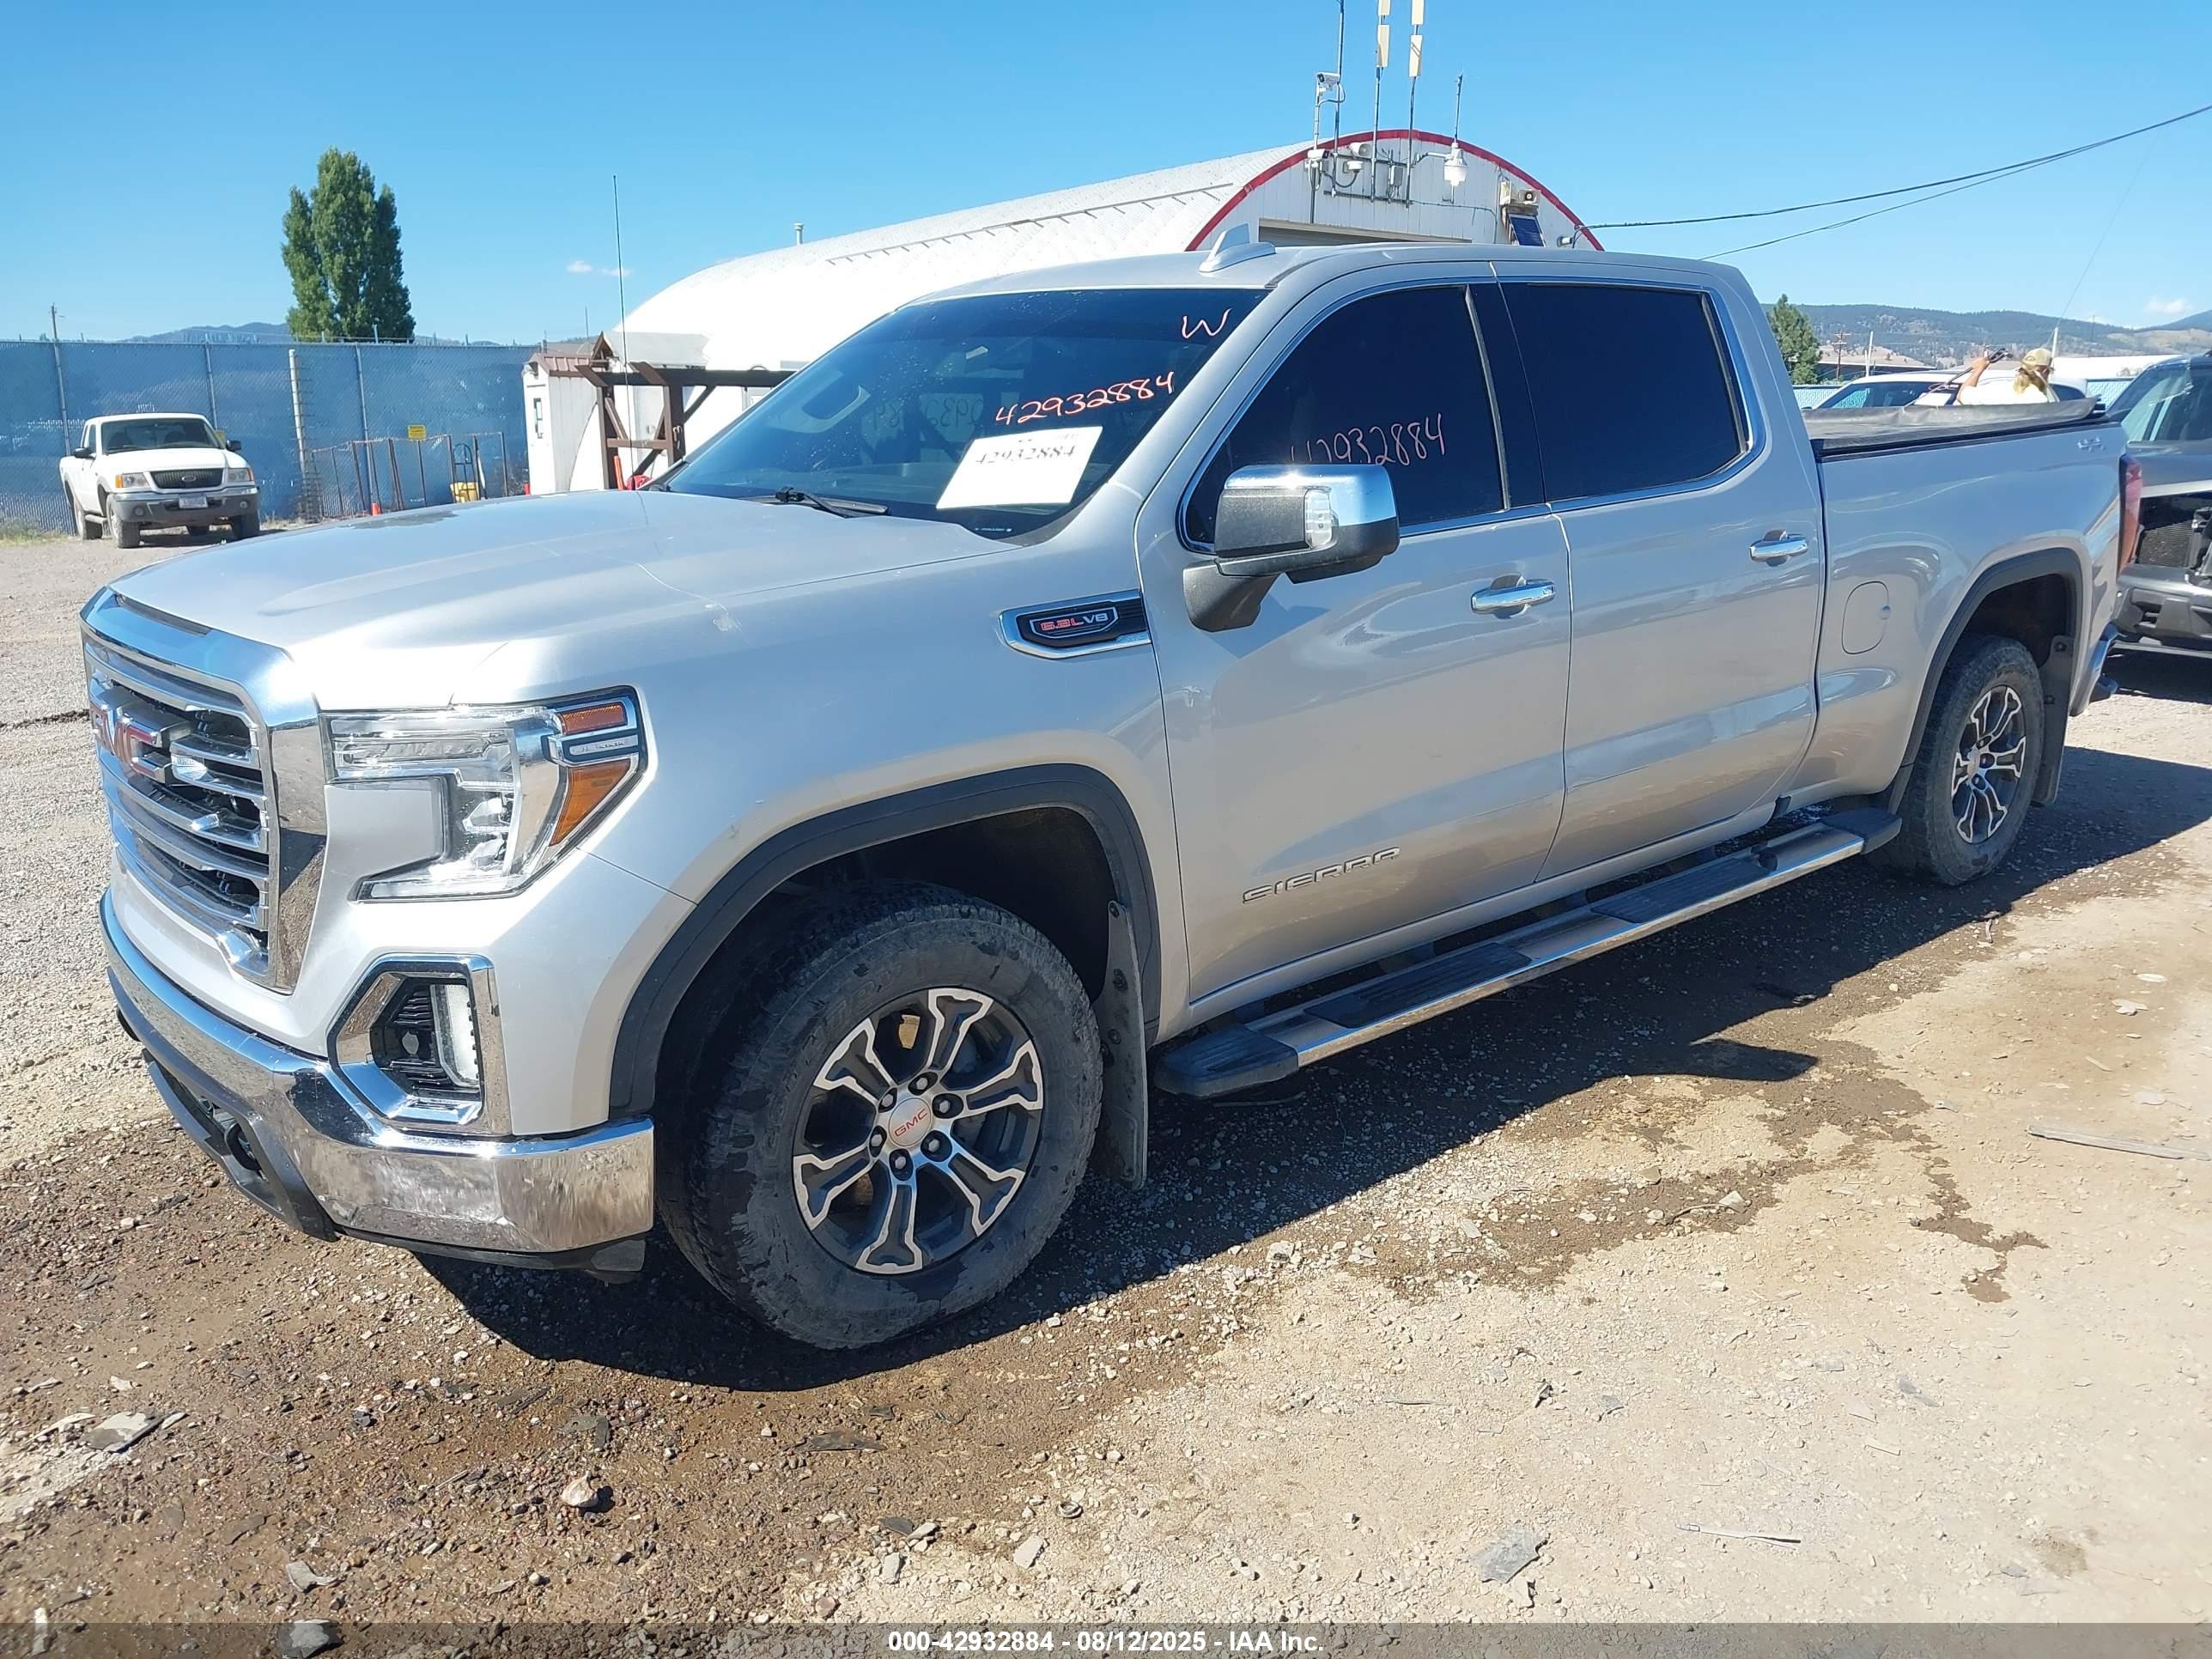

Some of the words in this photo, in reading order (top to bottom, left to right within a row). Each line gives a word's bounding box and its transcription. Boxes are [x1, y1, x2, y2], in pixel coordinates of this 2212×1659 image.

[1181, 307, 1233, 339] W
[994, 370, 1176, 426] 42932884
[1242, 846, 1401, 904] SIERRA
[893, 1107, 928, 1138] GMC
